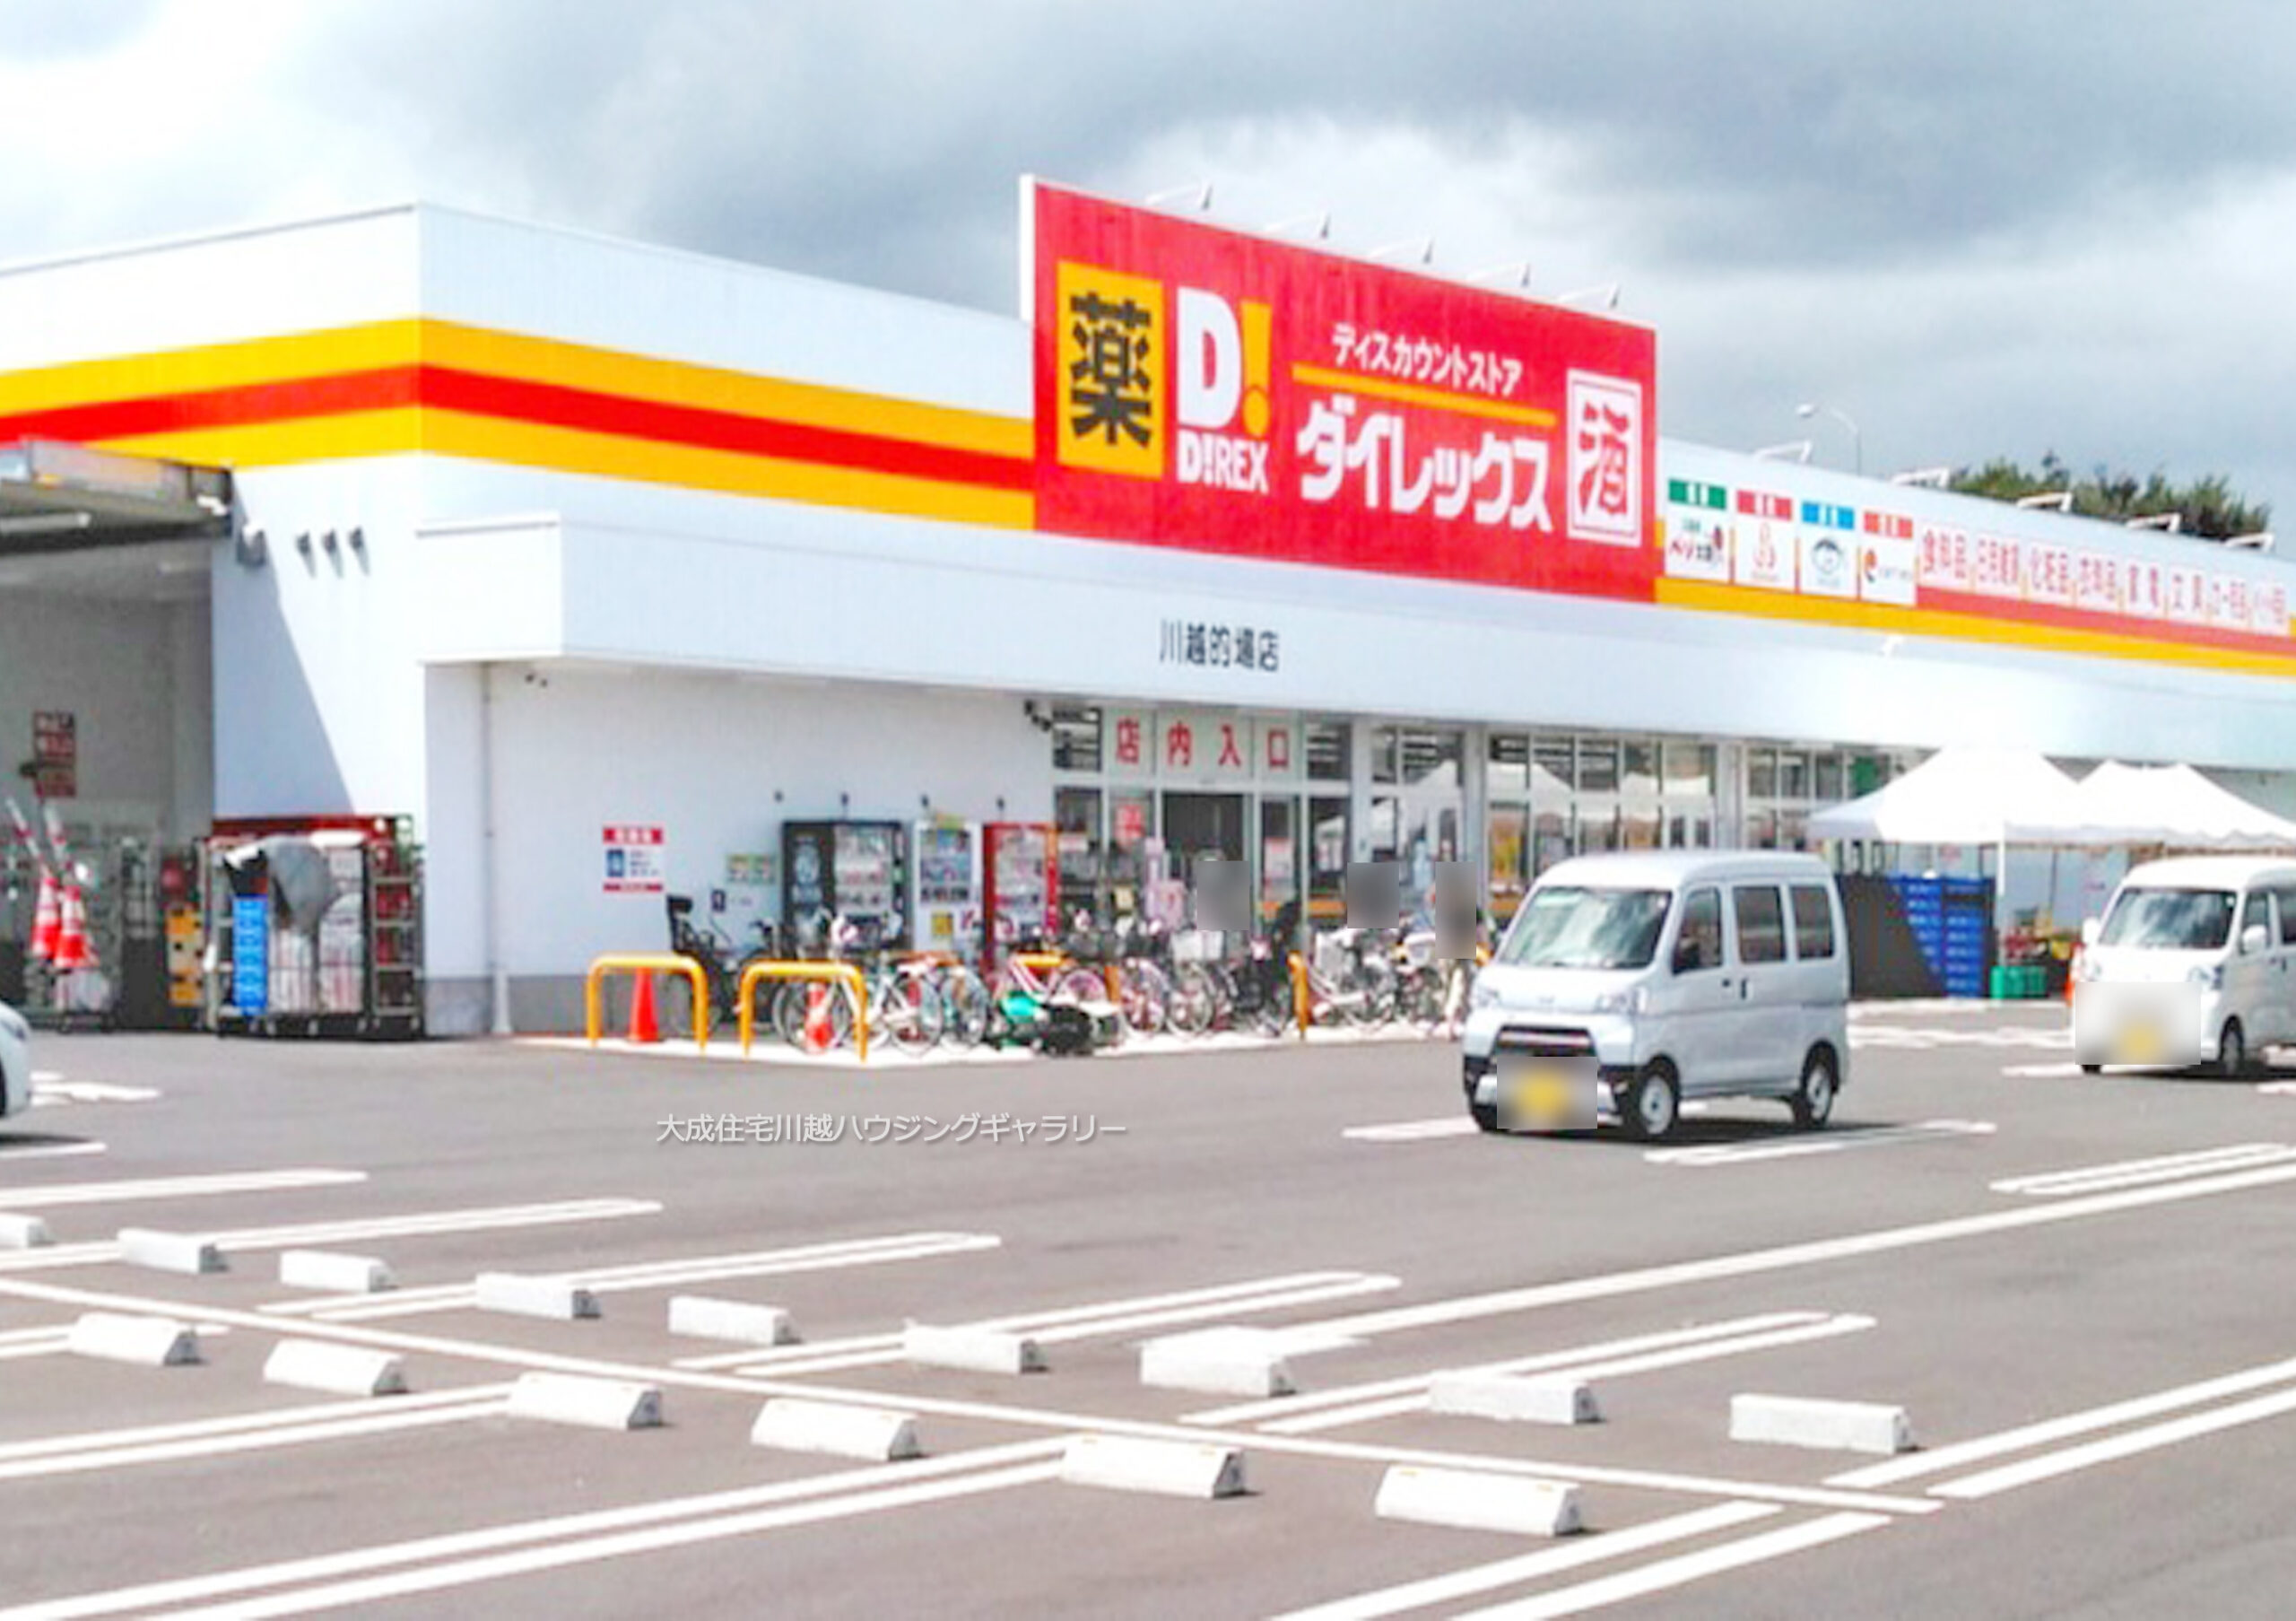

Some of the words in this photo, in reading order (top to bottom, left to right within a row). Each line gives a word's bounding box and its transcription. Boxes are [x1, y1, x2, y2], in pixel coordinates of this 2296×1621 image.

[1070, 291, 1152, 448] 薬
[1333, 323, 1523, 397] ディスカウントストア
[1297, 394, 1553, 533] ダイレックス
[1578, 401, 1630, 516] 酒
[1116, 717, 1289, 770] 店内入口
